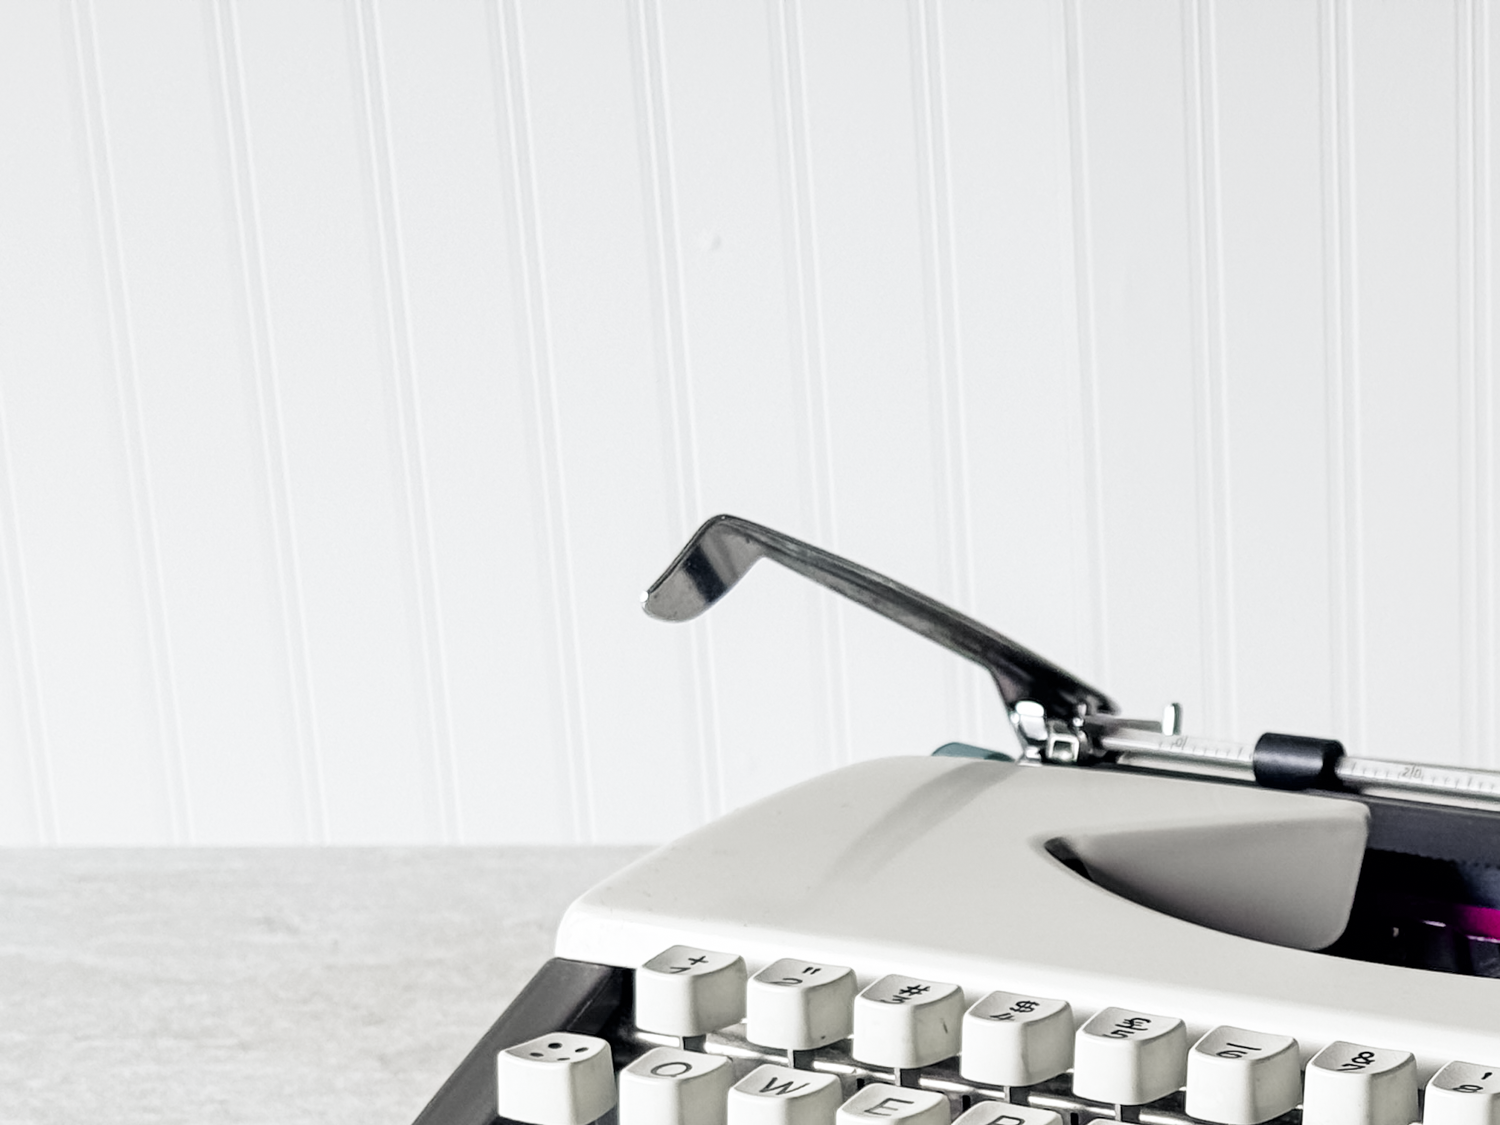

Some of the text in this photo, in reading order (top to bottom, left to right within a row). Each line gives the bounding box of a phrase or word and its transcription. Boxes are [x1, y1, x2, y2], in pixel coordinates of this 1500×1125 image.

[688, 956, 709, 966] +
[899, 984, 931, 996] #
[1009, 1000, 1040, 1013] $
[1102, 1029, 1135, 1039] 5
[1215, 1050, 1248, 1059] 6
[1351, 1051, 1375, 1065] &
[650, 1062, 692, 1077] Q
[1336, 1063, 1366, 1072] 7
[759, 1077, 810, 1095] W
[1452, 1084, 1484, 1093] 8
[864, 1098, 915, 1117] E
